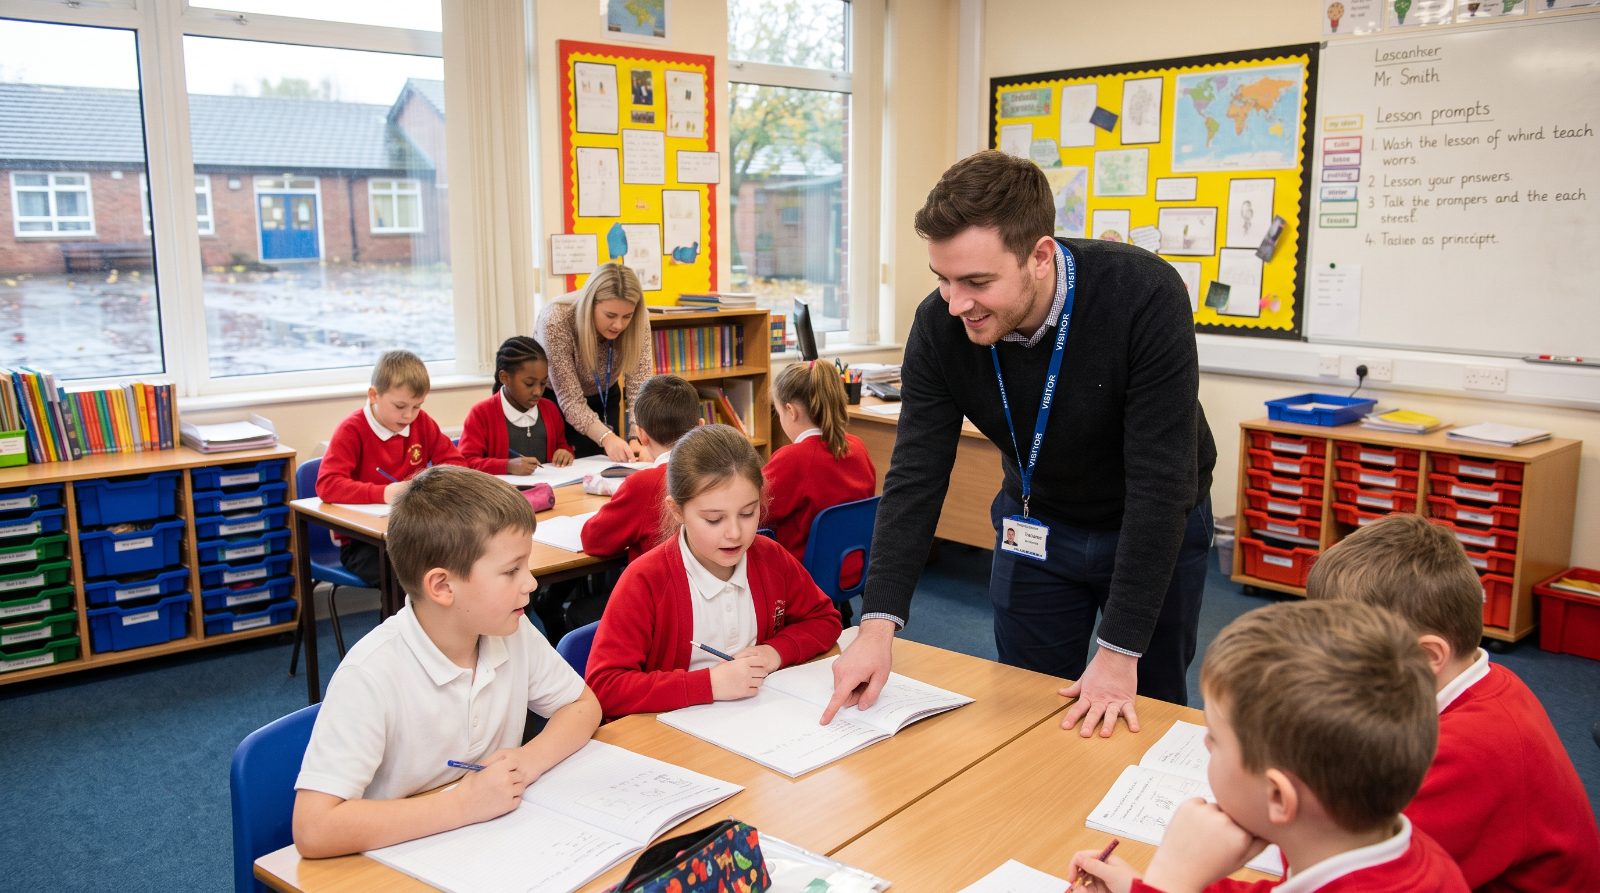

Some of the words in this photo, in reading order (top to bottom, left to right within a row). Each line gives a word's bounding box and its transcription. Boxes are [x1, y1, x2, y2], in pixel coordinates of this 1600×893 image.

[1400, 67, 1440, 85] Smith
[1376, 106, 1422, 123] Lesson
[1431, 100, 1490, 126] prompts
[1383, 136, 1413, 150] Wash
[1419, 135, 1438, 148] the
[1444, 133, 1480, 147] lesson
[1487, 129, 1501, 150] of
[1553, 123, 1594, 139] teach
[1384, 174, 1422, 188] Lesson
[1428, 176, 1455, 192] your
[1412, 195, 1430, 207] the
[1496, 190, 1520, 203] and
[1527, 189, 1549, 202] the
[1555, 187, 1587, 201] each
[1421, 236, 1435, 245] as
[1041, 374, 1056, 410] VISITOR
